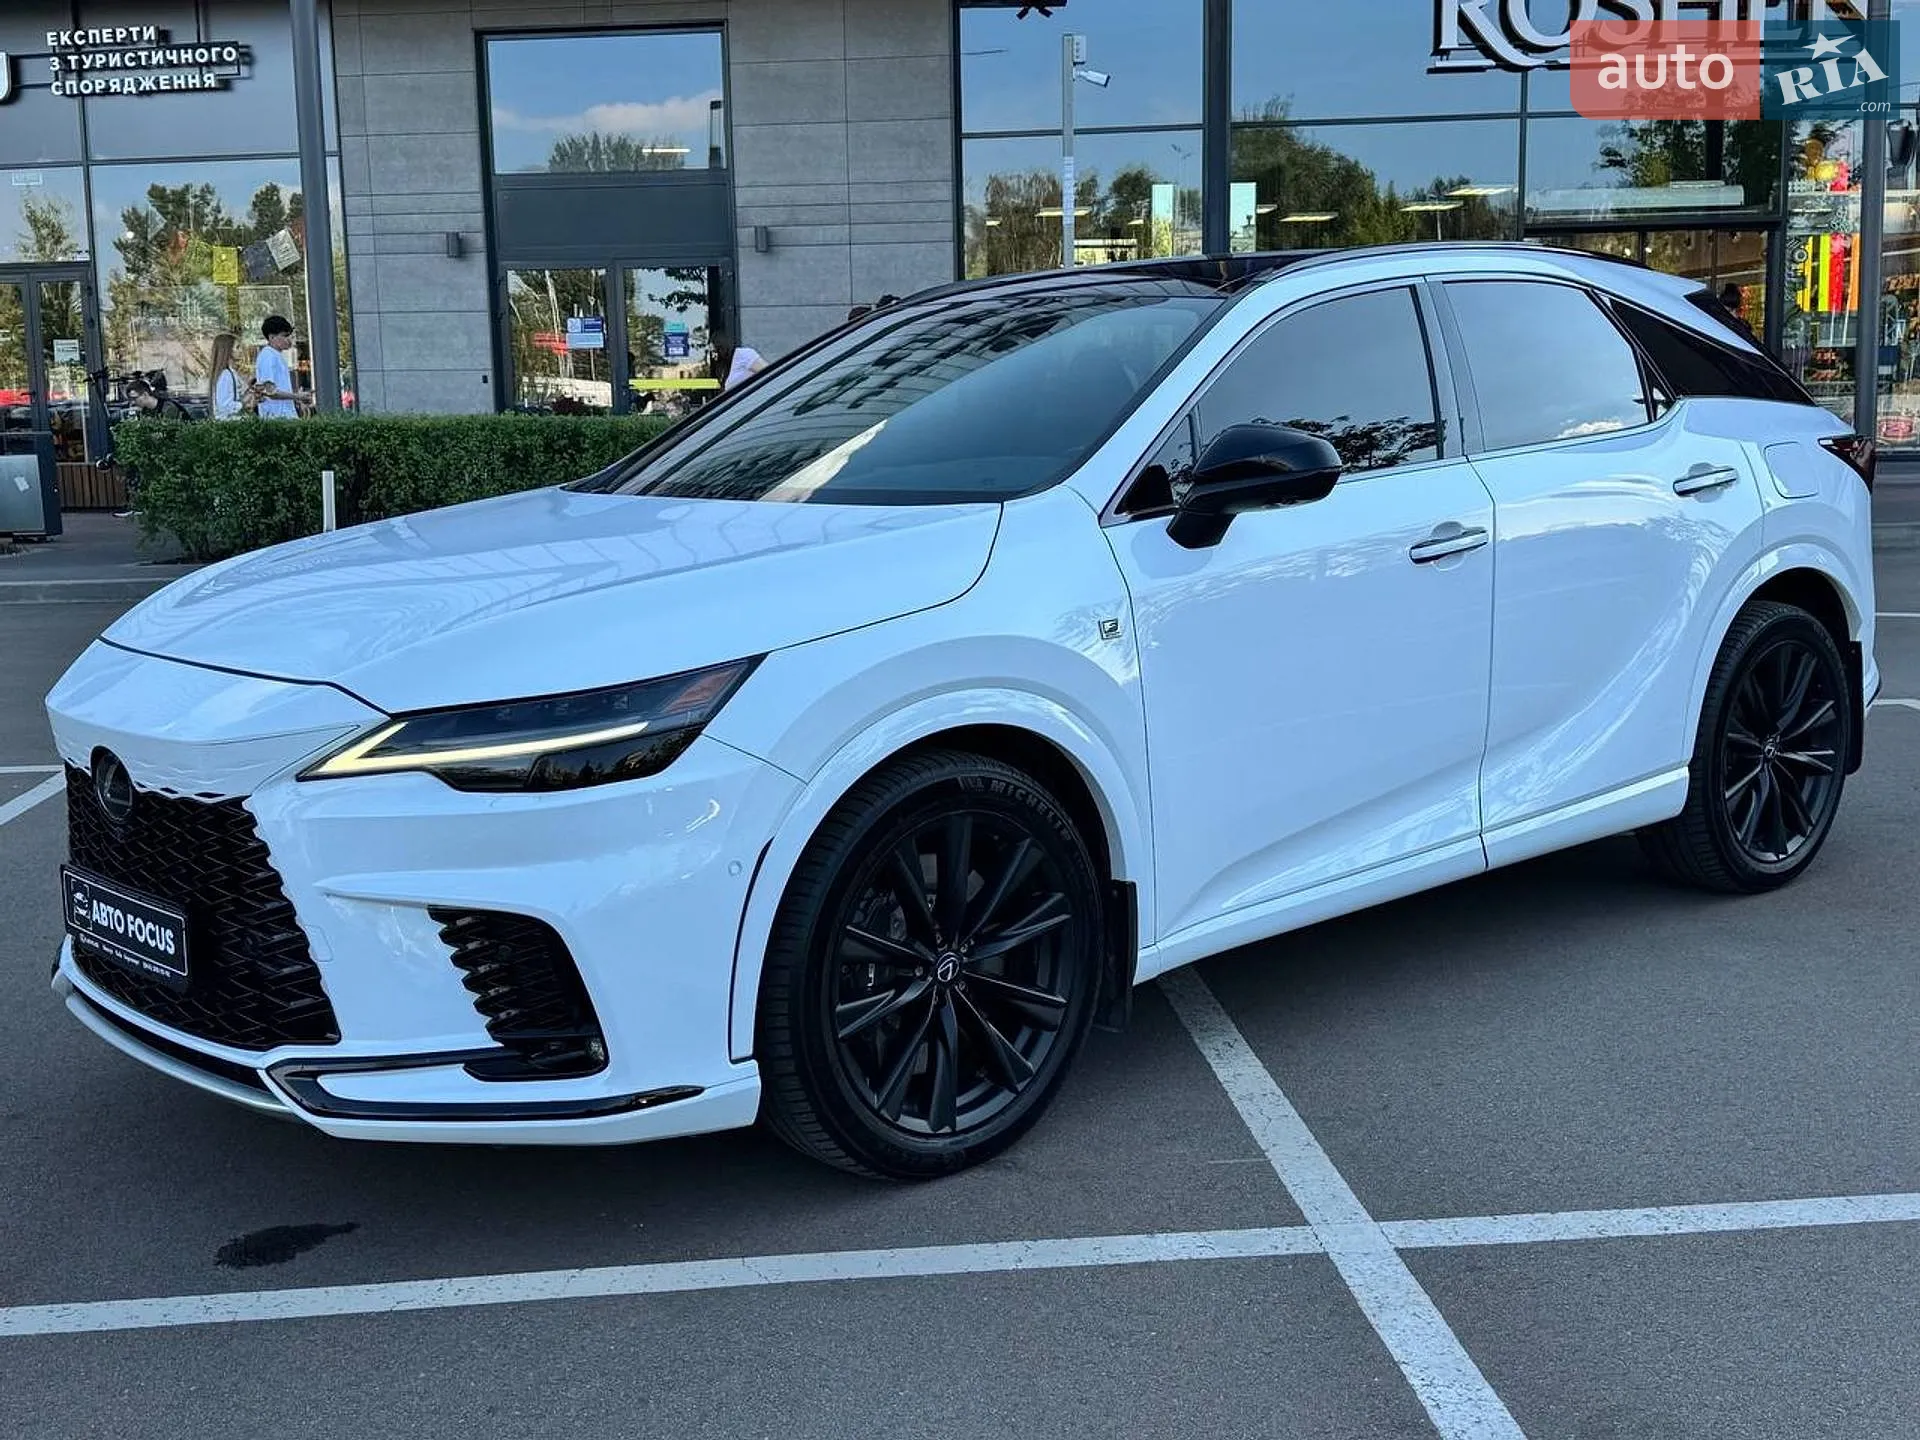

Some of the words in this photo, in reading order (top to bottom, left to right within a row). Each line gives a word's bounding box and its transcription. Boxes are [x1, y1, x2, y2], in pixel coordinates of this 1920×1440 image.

[46, 26, 156, 47] ЕКСПЕРТИ
[50, 58, 61, 71] З
[67, 46, 237, 71] ТУРИСТИЧНОГО
[51, 73, 216, 96] СПОРЯДЖЕННЯ
[990, 779, 1072, 841] MICHELIN
[127, 913, 176, 956] FOCUS
